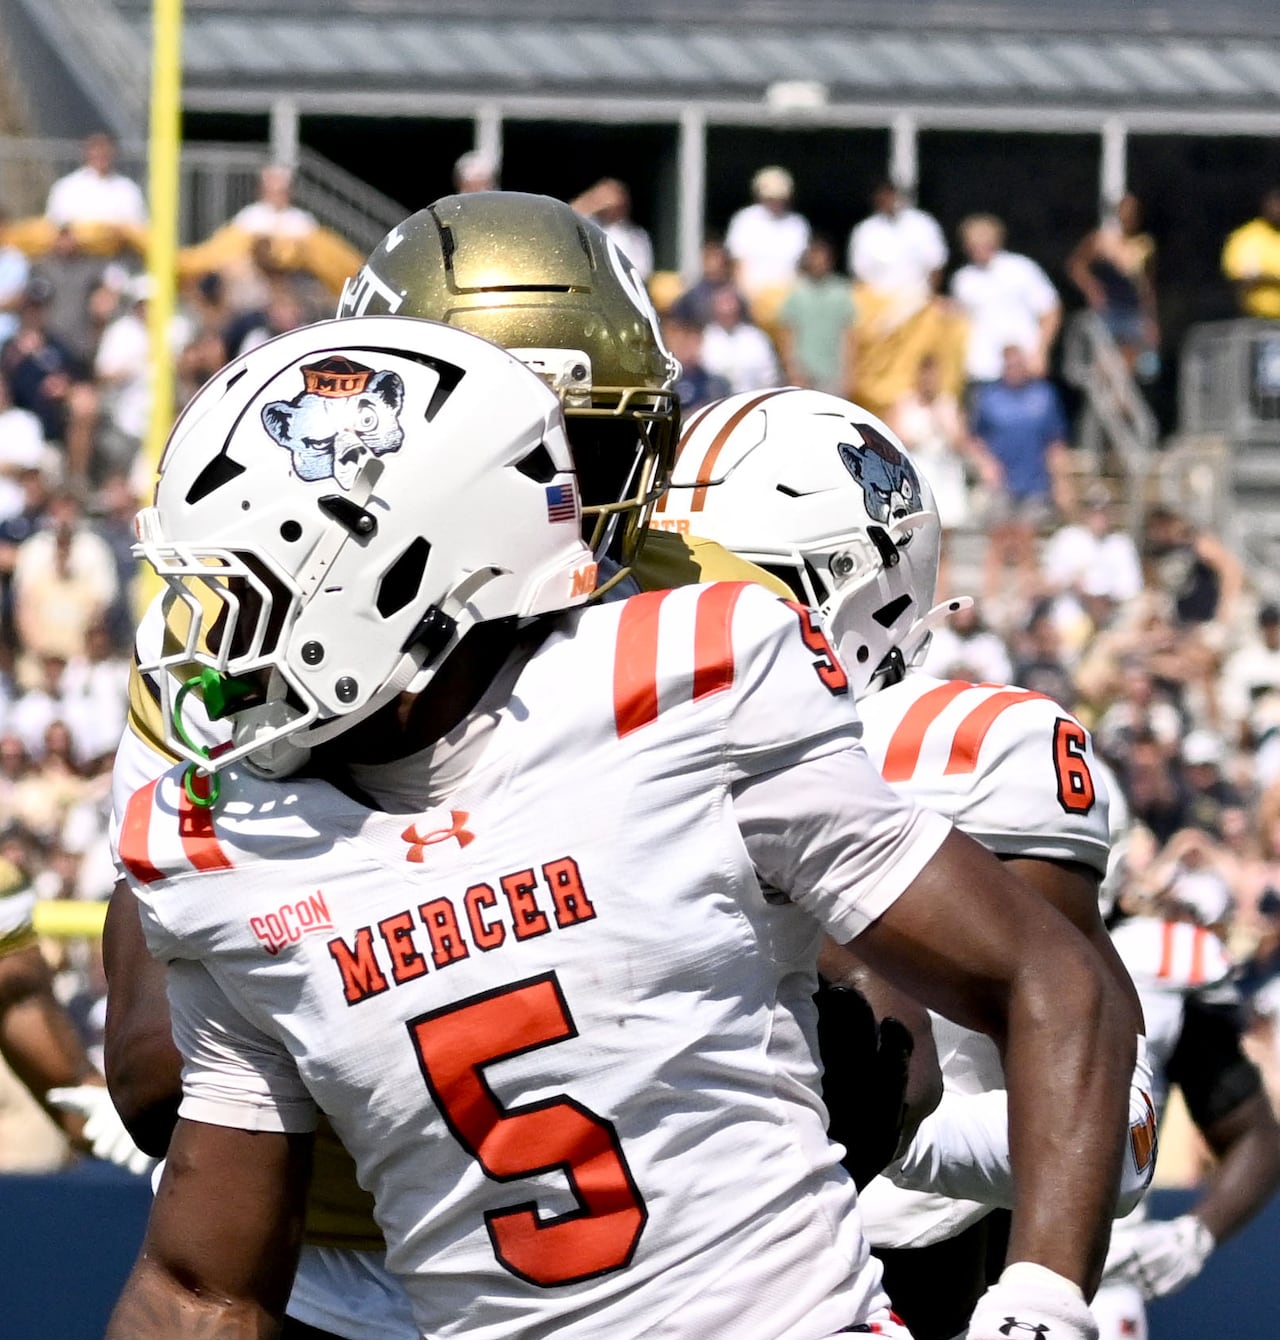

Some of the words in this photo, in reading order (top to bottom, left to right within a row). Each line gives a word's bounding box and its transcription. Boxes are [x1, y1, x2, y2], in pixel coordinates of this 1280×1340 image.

[317, 375, 360, 391] MU
[1052, 717, 1096, 816] 6
[328, 855, 597, 1007] MERCER
[406, 970, 649, 1288] 5
